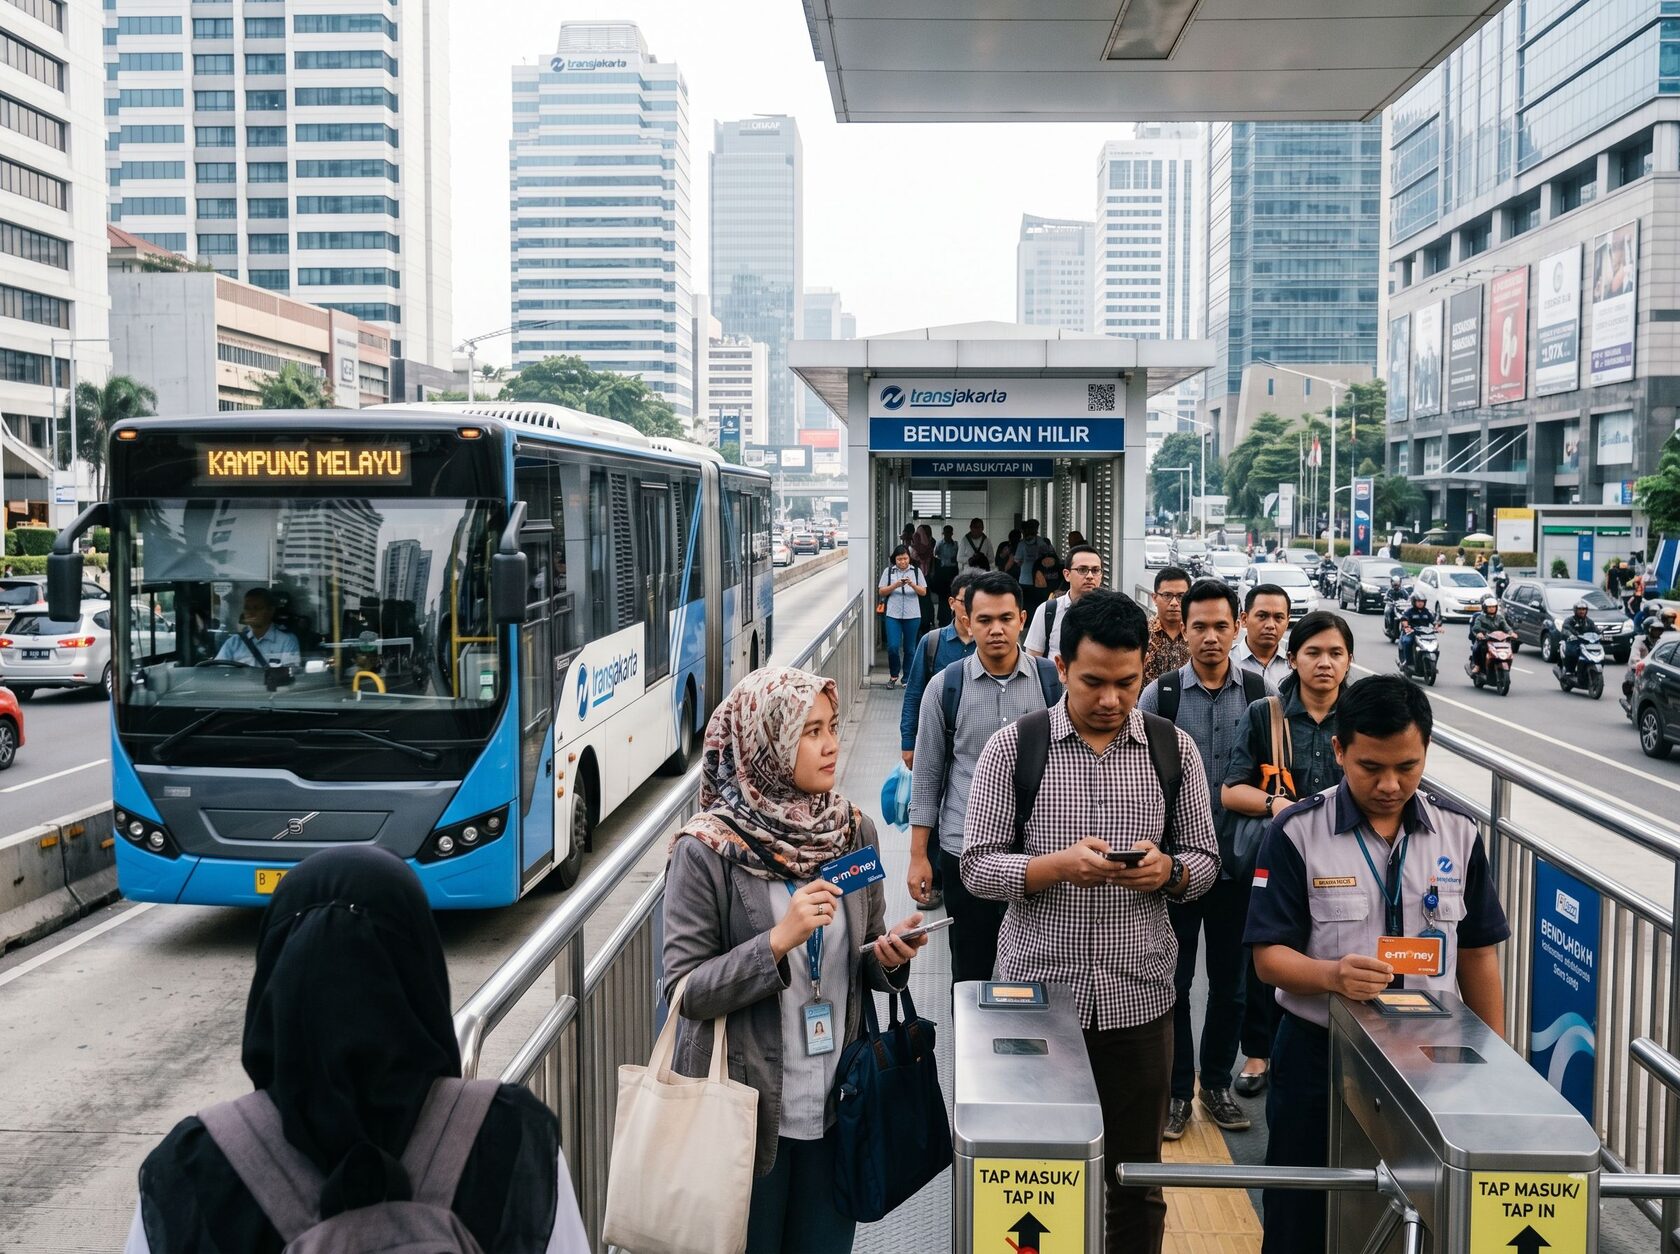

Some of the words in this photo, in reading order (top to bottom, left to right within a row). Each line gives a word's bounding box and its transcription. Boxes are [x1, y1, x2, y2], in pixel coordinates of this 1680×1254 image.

[567, 58, 627, 70] transjakarta
[910, 388, 1007, 406] transjakarta
[903, 425, 1032, 443] BENDUNGAN
[1038, 426, 1090, 443] HILIR
[208, 451, 309, 476] KAMPUNG
[317, 451, 401, 476] MELAYU
[932, 462, 954, 472] TAP
[956, 462, 1019, 472] MASUK/TAP
[1022, 462, 1033, 472] IN
[592, 649, 638, 697] transjakarta
[259, 873, 265, 885] B
[1385, 950, 1434, 962] e-money
[980, 1169, 1010, 1184] TAP
[1015, 1170, 1080, 1187] MASUK/
[1003, 1190, 1034, 1205] TAP
[1039, 1191, 1055, 1205] IN
[1479, 1182, 1510, 1196] TAP
[1514, 1182, 1580, 1199] MASUK/
[1502, 1203, 1534, 1218] TAP
[1538, 1204, 1555, 1218] IN
